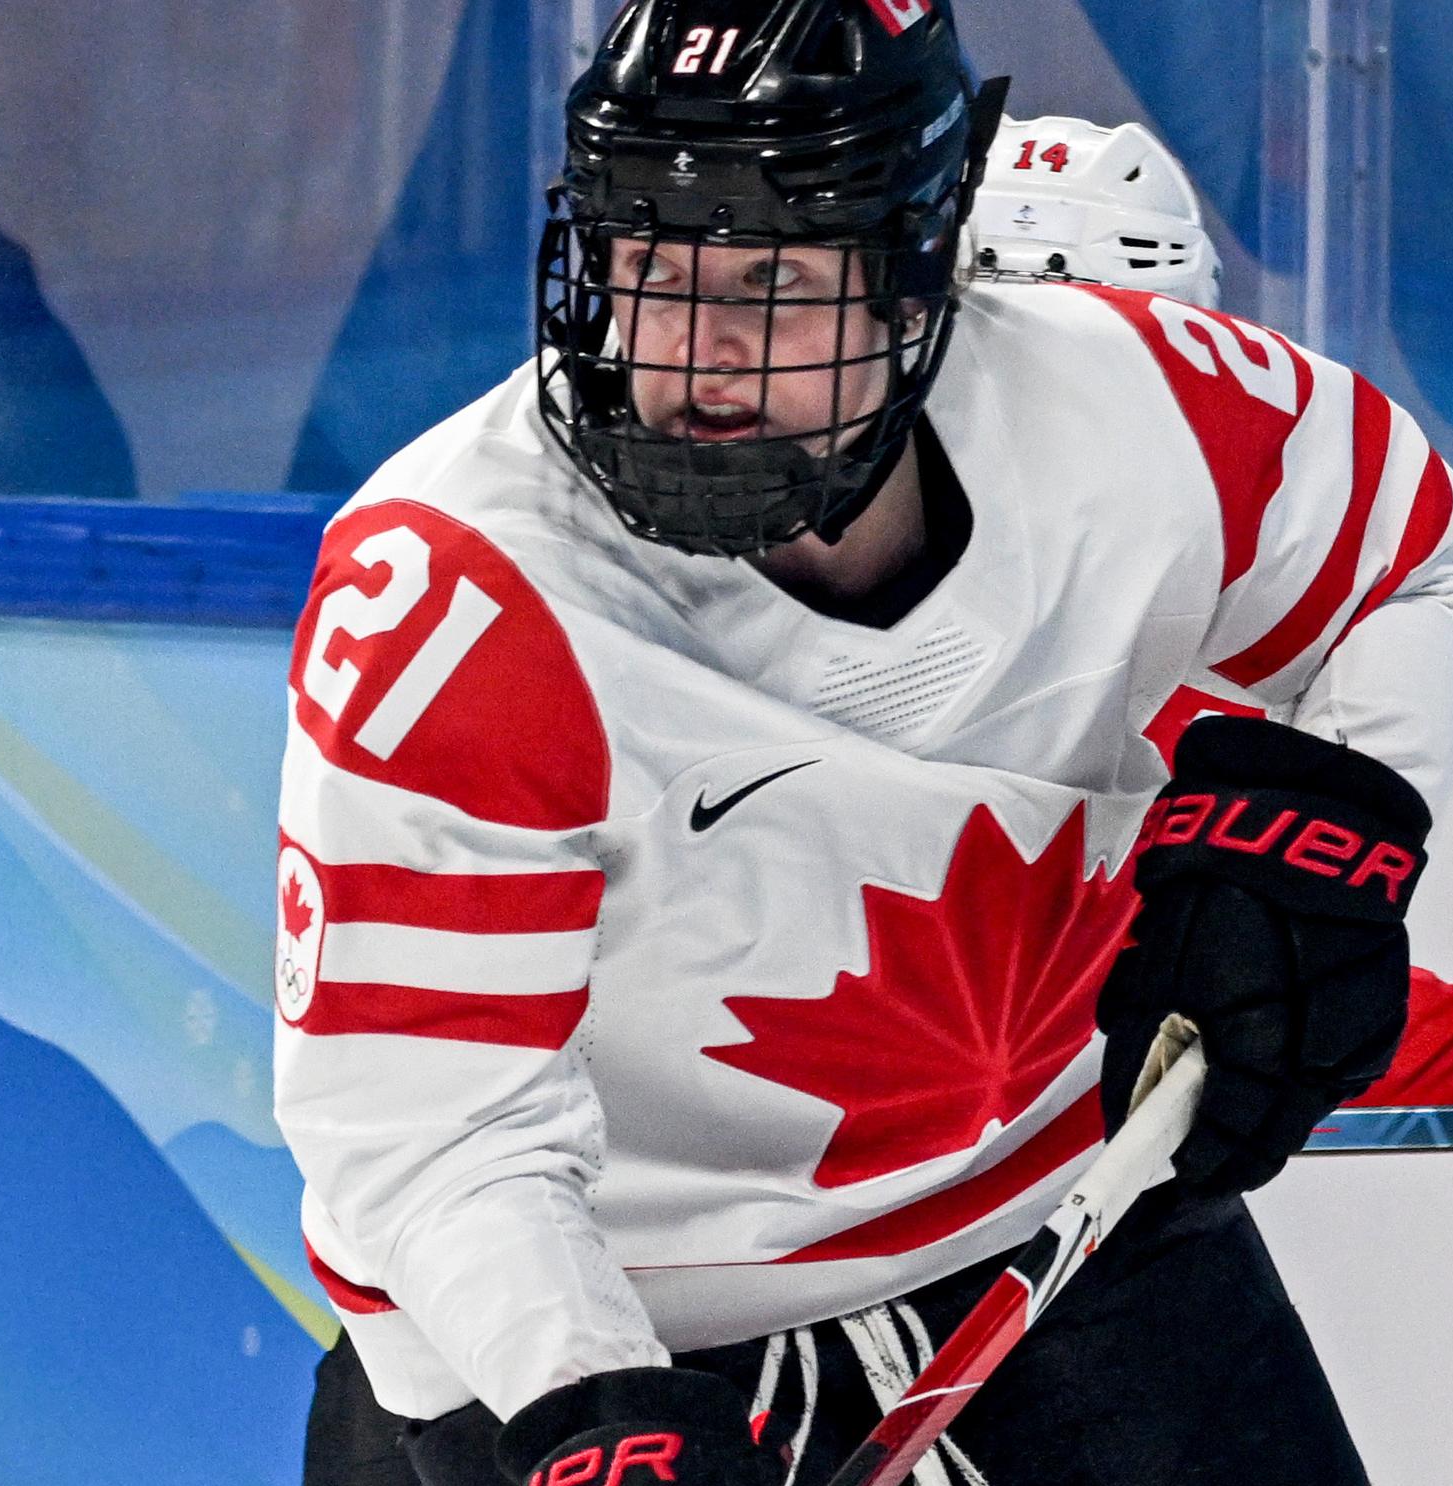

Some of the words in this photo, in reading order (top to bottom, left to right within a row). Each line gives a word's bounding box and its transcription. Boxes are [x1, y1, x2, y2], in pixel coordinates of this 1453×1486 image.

[672, 27, 740, 74] 21
[1012, 140, 1069, 173] 14
[1147, 296, 1299, 417] 2
[302, 524, 504, 762] 21
